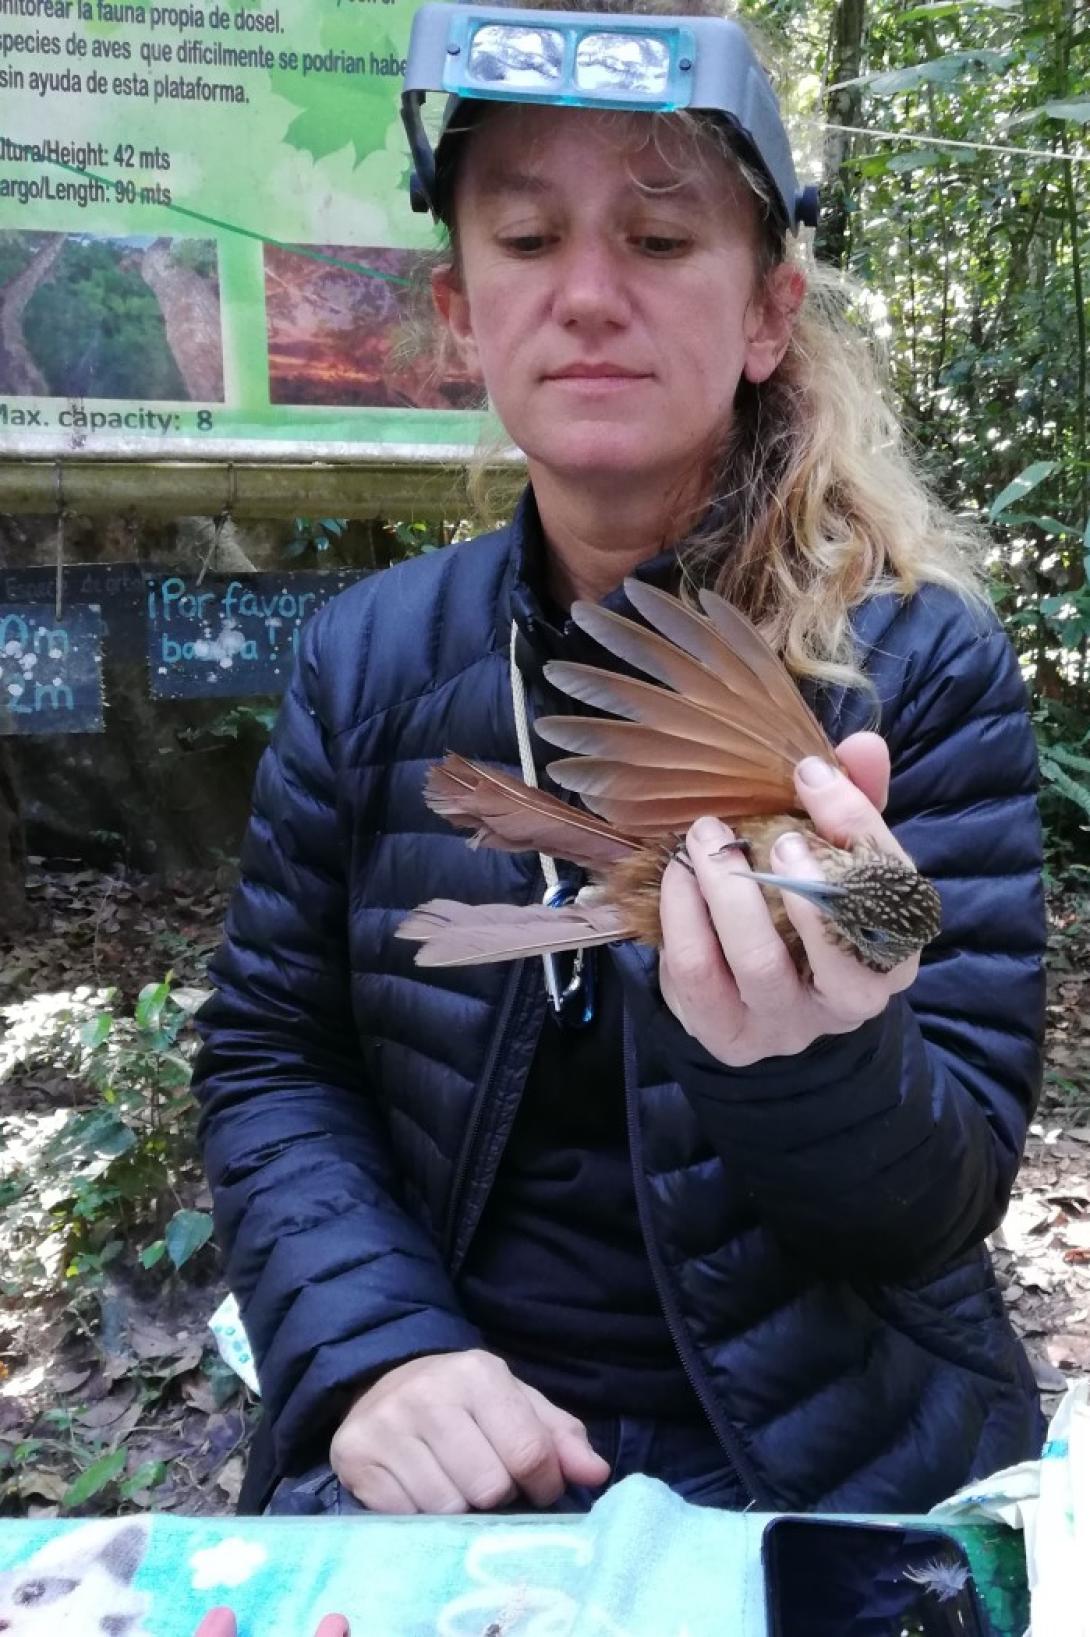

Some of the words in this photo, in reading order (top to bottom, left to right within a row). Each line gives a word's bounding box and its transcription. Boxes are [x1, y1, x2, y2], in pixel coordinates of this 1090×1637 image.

[78, 0, 93, 20] la
[96, 0, 146, 24] fauna
[150, 4, 205, 33] propia
[208, 5, 230, 30] de
[234, 8, 285, 34] dosel.
[0, 30, 61, 57] pecies
[65, 32, 87, 57] de
[91, 40, 131, 59] aves
[140, 42, 172, 67] que
[177, 39, 274, 70] dificilmente
[278, 51, 299, 70] se
[302, 49, 366, 77] podrian
[369, 52, 407, 77] habe
[0, 64, 24, 90] sin
[28, 67, 82, 98] ayuda
[86, 69, 108, 94] de
[112, 73, 149, 97] esta
[153, 75, 250, 104] plataforma.
[0, 136, 109, 171] ltura/Height:
[113, 143, 135, 168] 42
[139, 146, 171, 170] mts
[0, 175, 110, 208] argo/Length:
[115, 180, 136, 204] 90
[140, 183, 172, 206] mts
[58, 408, 180, 433] capacity:
[196, 409, 213, 431] 8
[221, 580, 316, 618] favor
